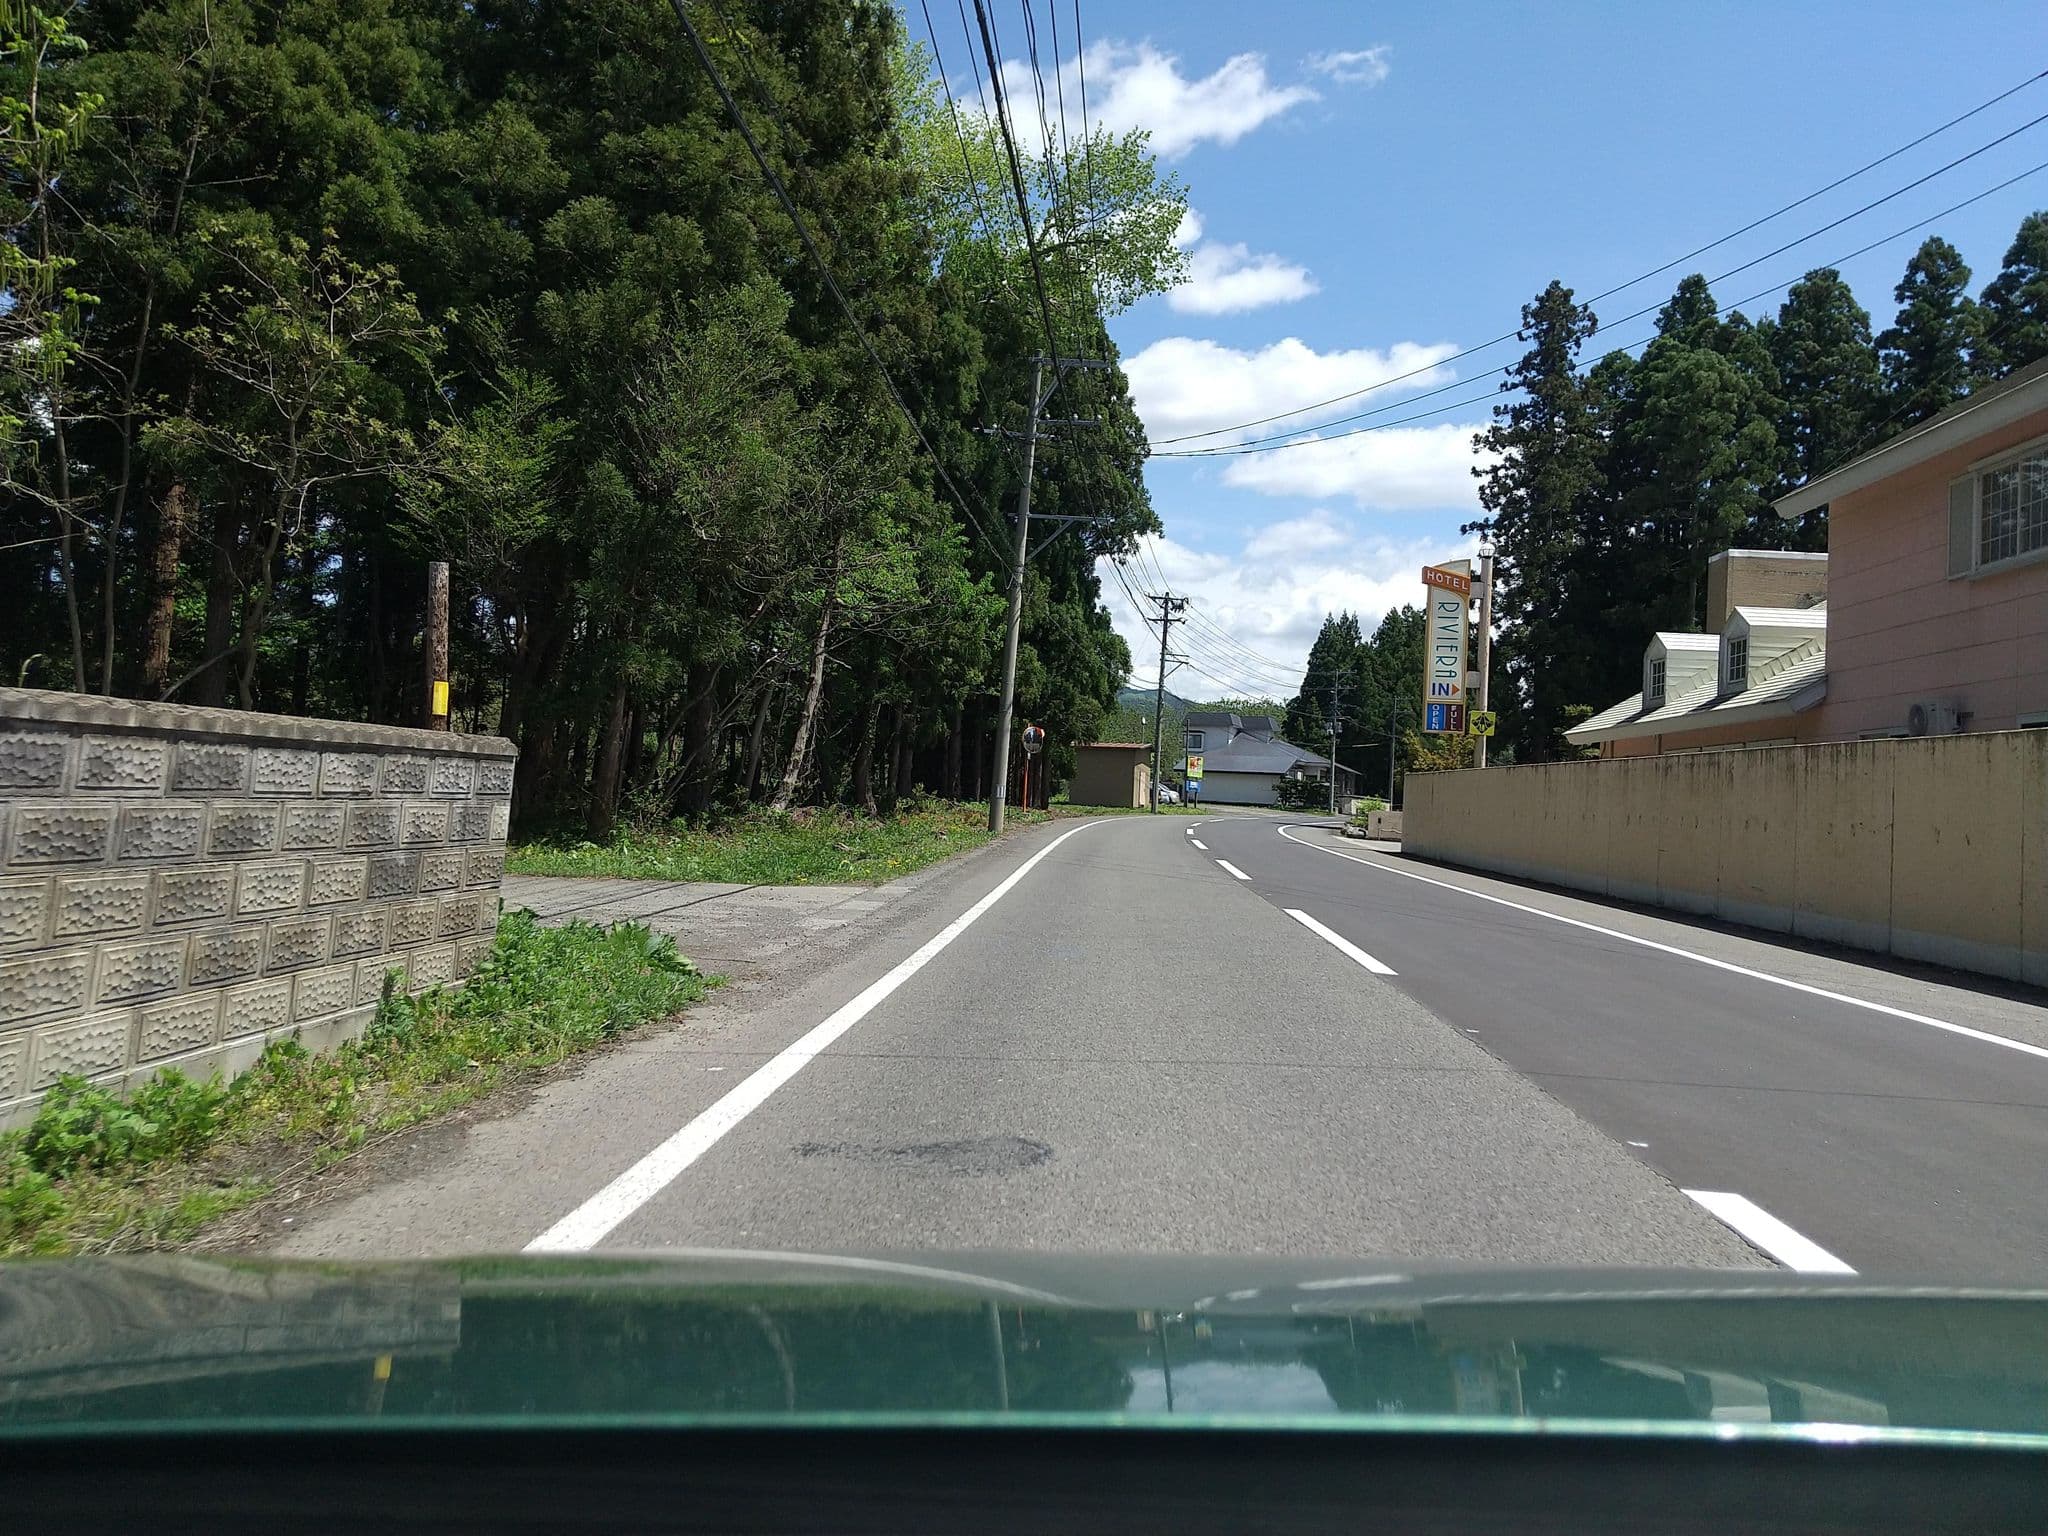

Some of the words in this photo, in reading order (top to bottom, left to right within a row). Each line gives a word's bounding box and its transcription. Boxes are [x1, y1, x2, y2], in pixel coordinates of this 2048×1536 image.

[1426, 570, 1469, 591] HOTEL
[1435, 602, 1460, 678] RIVIERA
[1431, 682, 1450, 696] IN
[1432, 704, 1440, 730] OPEN
[1450, 705, 1458, 731] FULL
